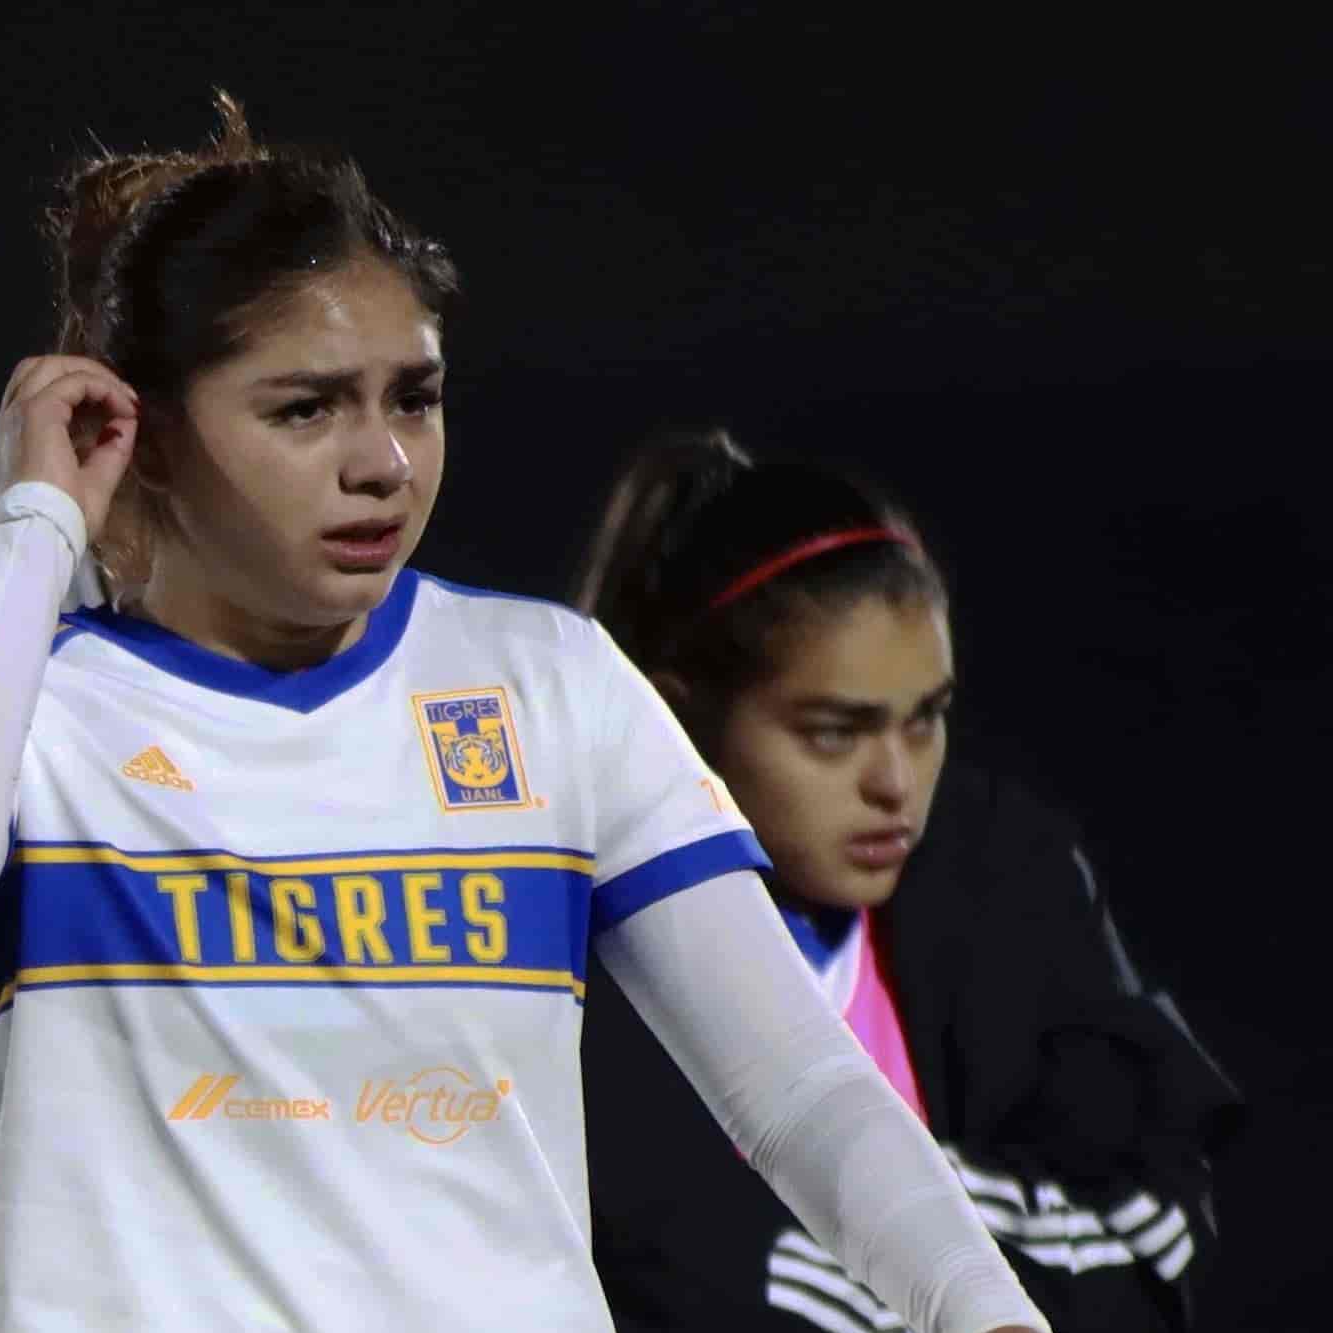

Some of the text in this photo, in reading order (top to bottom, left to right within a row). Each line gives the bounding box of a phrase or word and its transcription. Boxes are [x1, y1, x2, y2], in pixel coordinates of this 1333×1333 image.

[425, 699, 501, 721] TIGRES
[157, 872, 508, 964] TIGRES
[355, 1078, 501, 1123] Vertua
